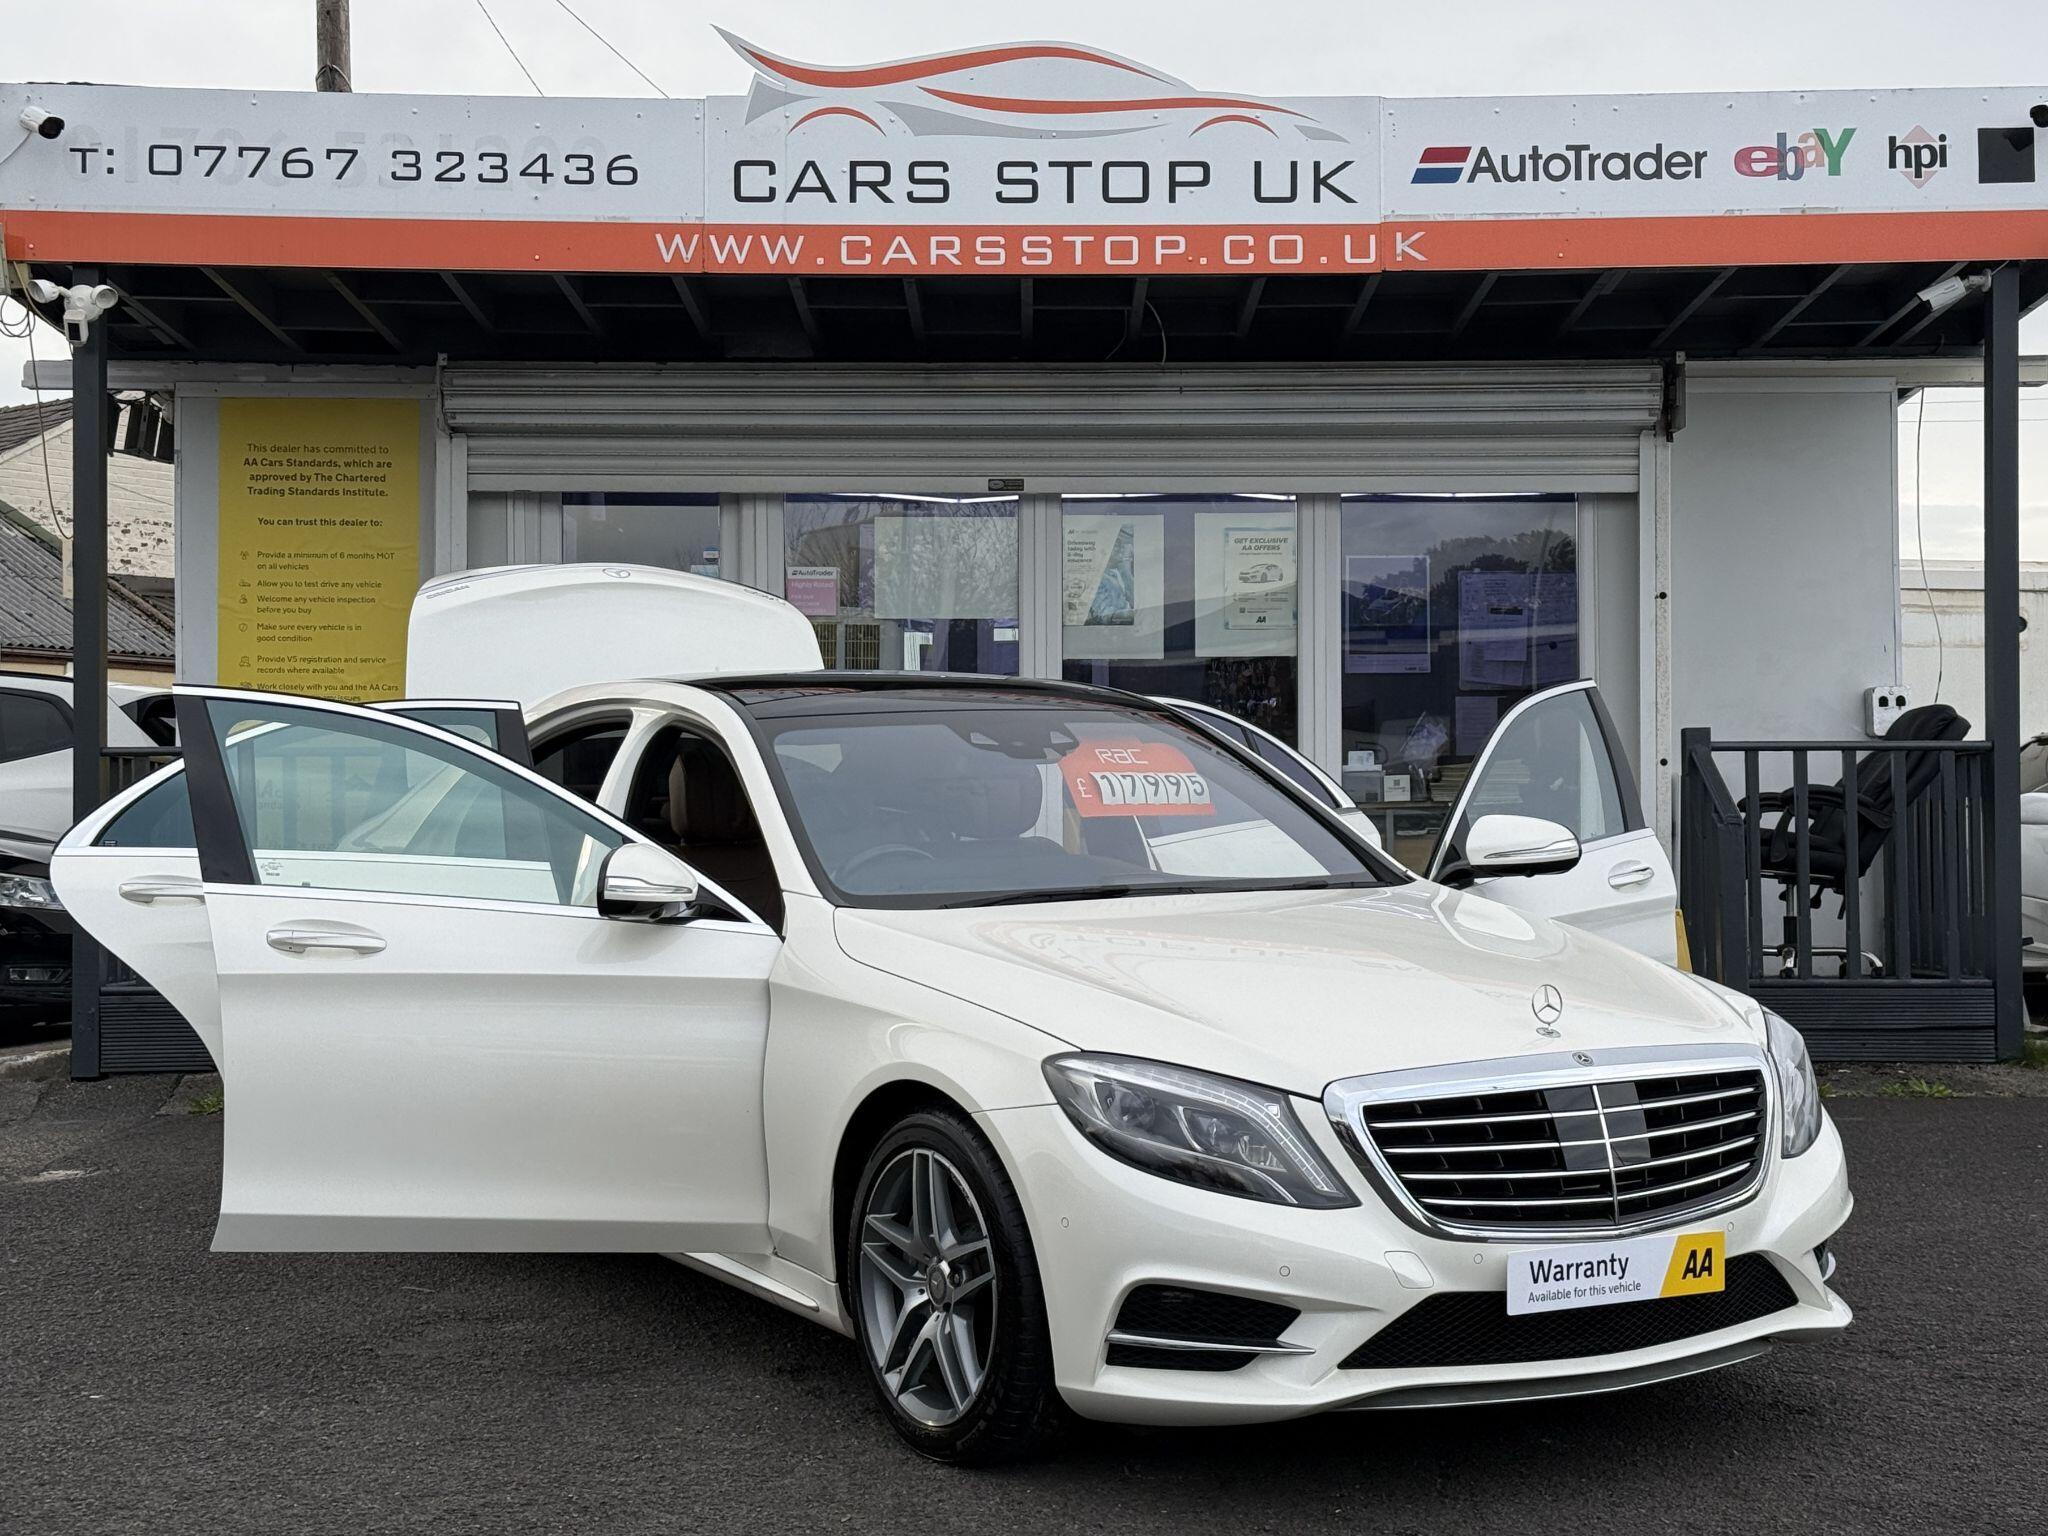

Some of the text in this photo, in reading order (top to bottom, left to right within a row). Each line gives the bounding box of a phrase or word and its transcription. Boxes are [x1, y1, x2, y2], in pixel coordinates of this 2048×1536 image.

[1887, 132, 1948, 179] hpi
[69, 144, 640, 186] T: 07767 323436
[1466, 143, 1708, 183] AutoTrader
[732, 159, 1359, 205] CARS STOP UK
[654, 231, 1429, 267] WWW.CARSSTOP.CO.UK
[247, 443, 389, 454] This dealer has committed to
[243, 458, 258, 467] AA
[260, 458, 284, 467] Cars
[344, 460, 374, 468] which
[376, 461, 393, 469] are
[249, 473, 386, 483] approved by The Chartered
[247, 486, 286, 497] Trading
[288, 487, 340, 496] Standards
[257, 517, 275, 526] You
[295, 518, 318, 526] trust
[320, 518, 337, 526] this
[339, 518, 368, 527] dealer
[256, 550, 286, 559] Provide
[376, 552, 396, 560] MOT
[256, 595, 292, 603] Welcome
[294, 596, 308, 604] any
[336, 596, 376, 604] inspection
[297, 606, 312, 615] buy
[256, 622, 278, 630] Make
[296, 624, 318, 632] every
[318, 624, 346, 632] vehicle
[256, 634, 313, 643] good condition
[299, 656, 342, 664] registration
[278, 682, 305, 692] closely
[1100, 774, 1206, 798] 17995
[1529, 1247, 1713, 1285] Warranty AA
[1528, 1280, 1642, 1304] Available for this vehicle
